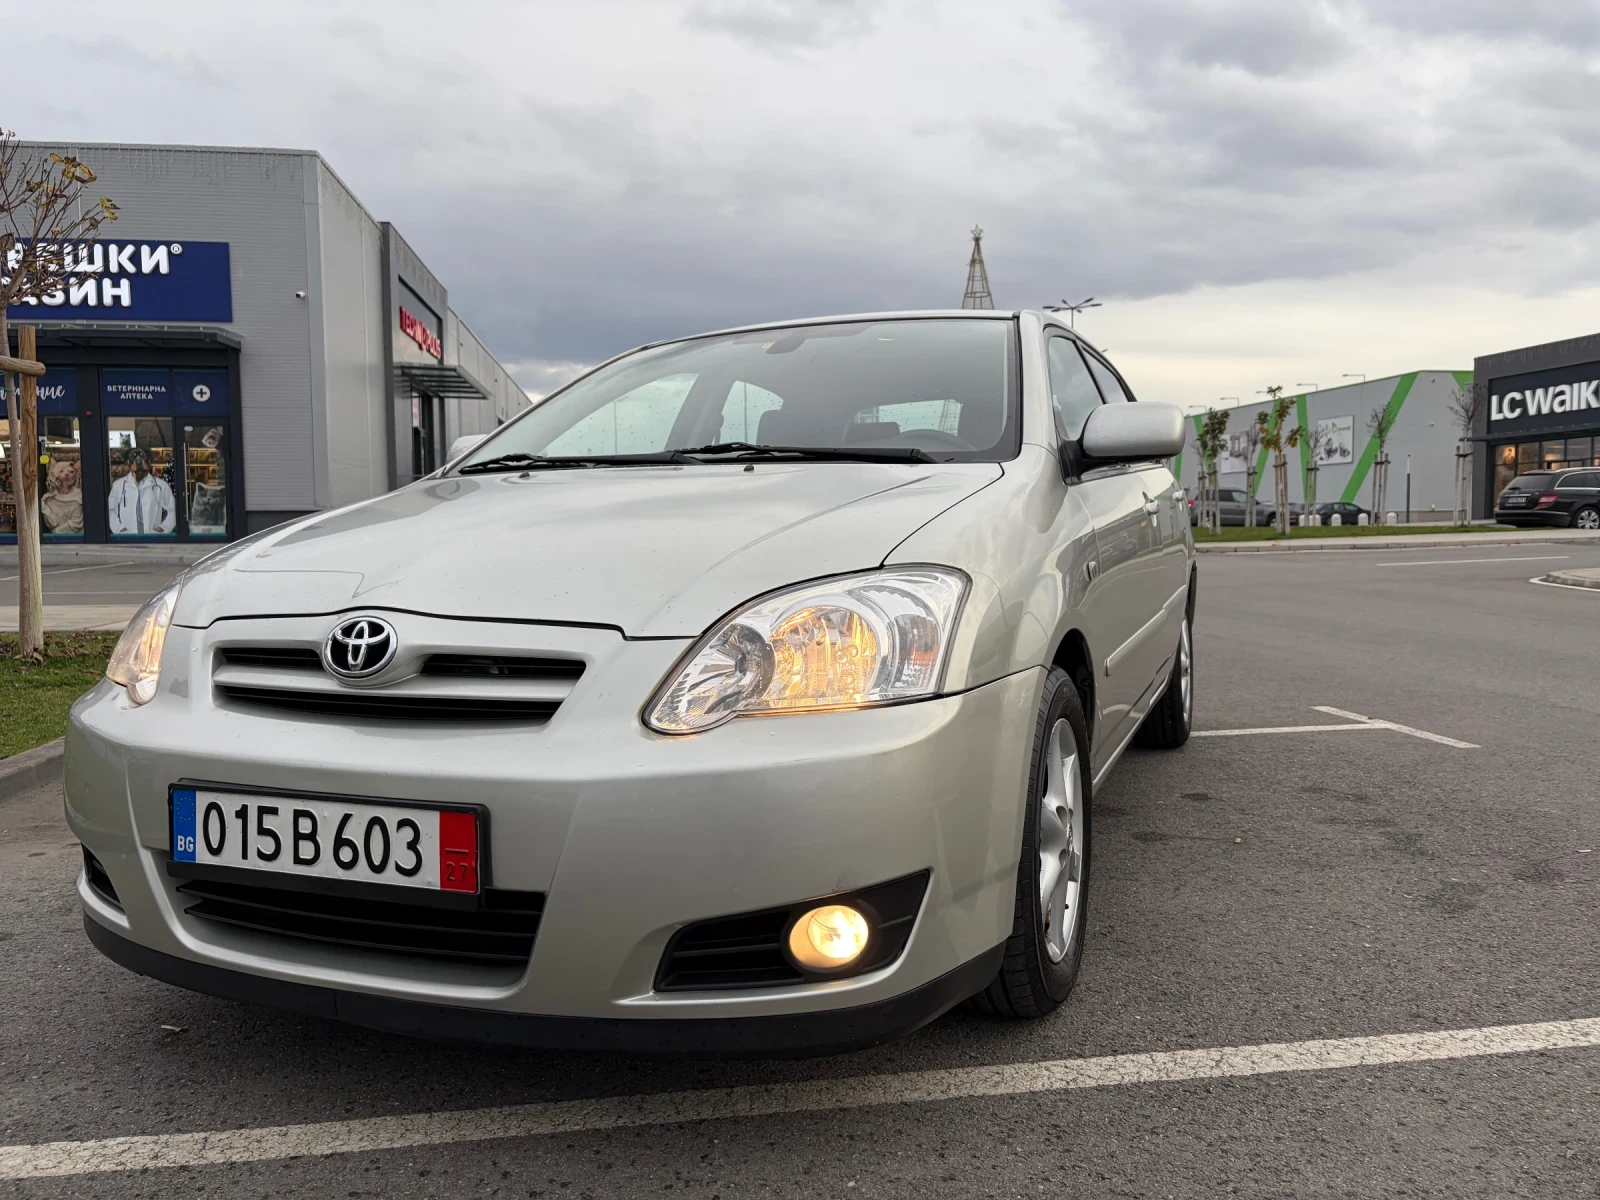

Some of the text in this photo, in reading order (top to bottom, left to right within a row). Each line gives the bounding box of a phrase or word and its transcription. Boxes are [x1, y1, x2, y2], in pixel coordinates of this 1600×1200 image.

[107, 384, 167, 393] ВЕТЕРИНАРНА
[177, 835, 194, 853] BG
[446, 861, 468, 882] 27
